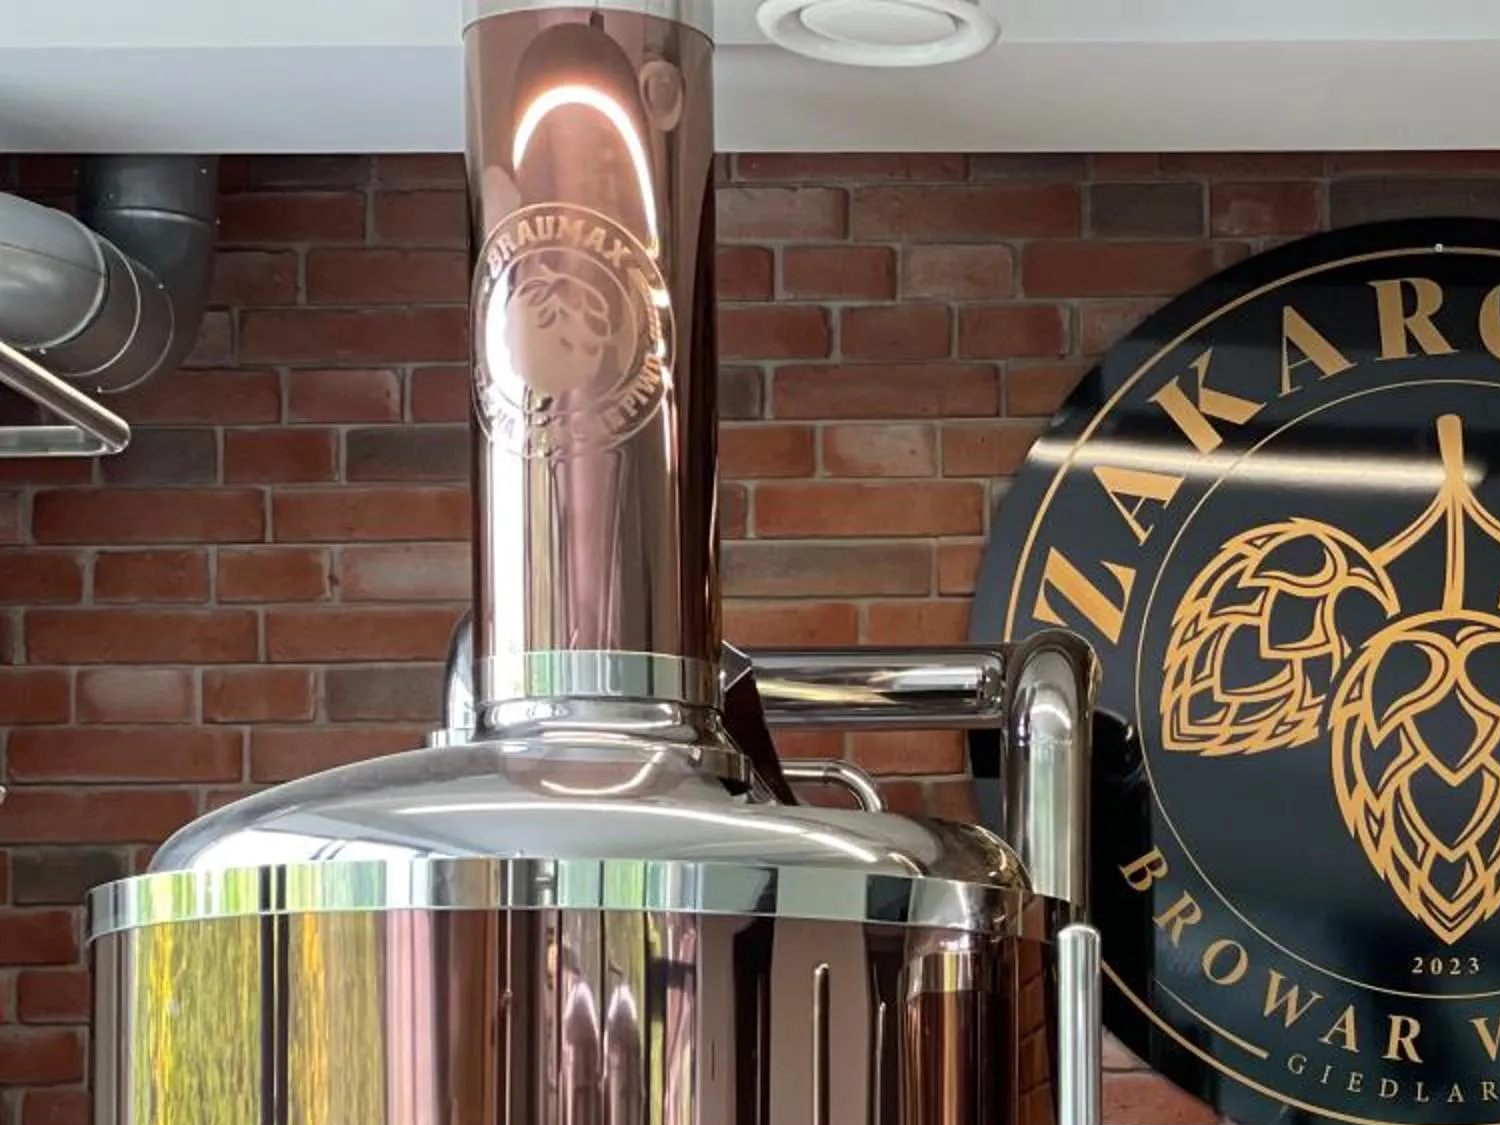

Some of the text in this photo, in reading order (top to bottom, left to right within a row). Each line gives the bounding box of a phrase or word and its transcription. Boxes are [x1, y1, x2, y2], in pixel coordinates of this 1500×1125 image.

[486, 214, 633, 279] BRAUMAX
[1118, 846, 1424, 1064] BROWAR
[1411, 956, 1481, 977] 2023
